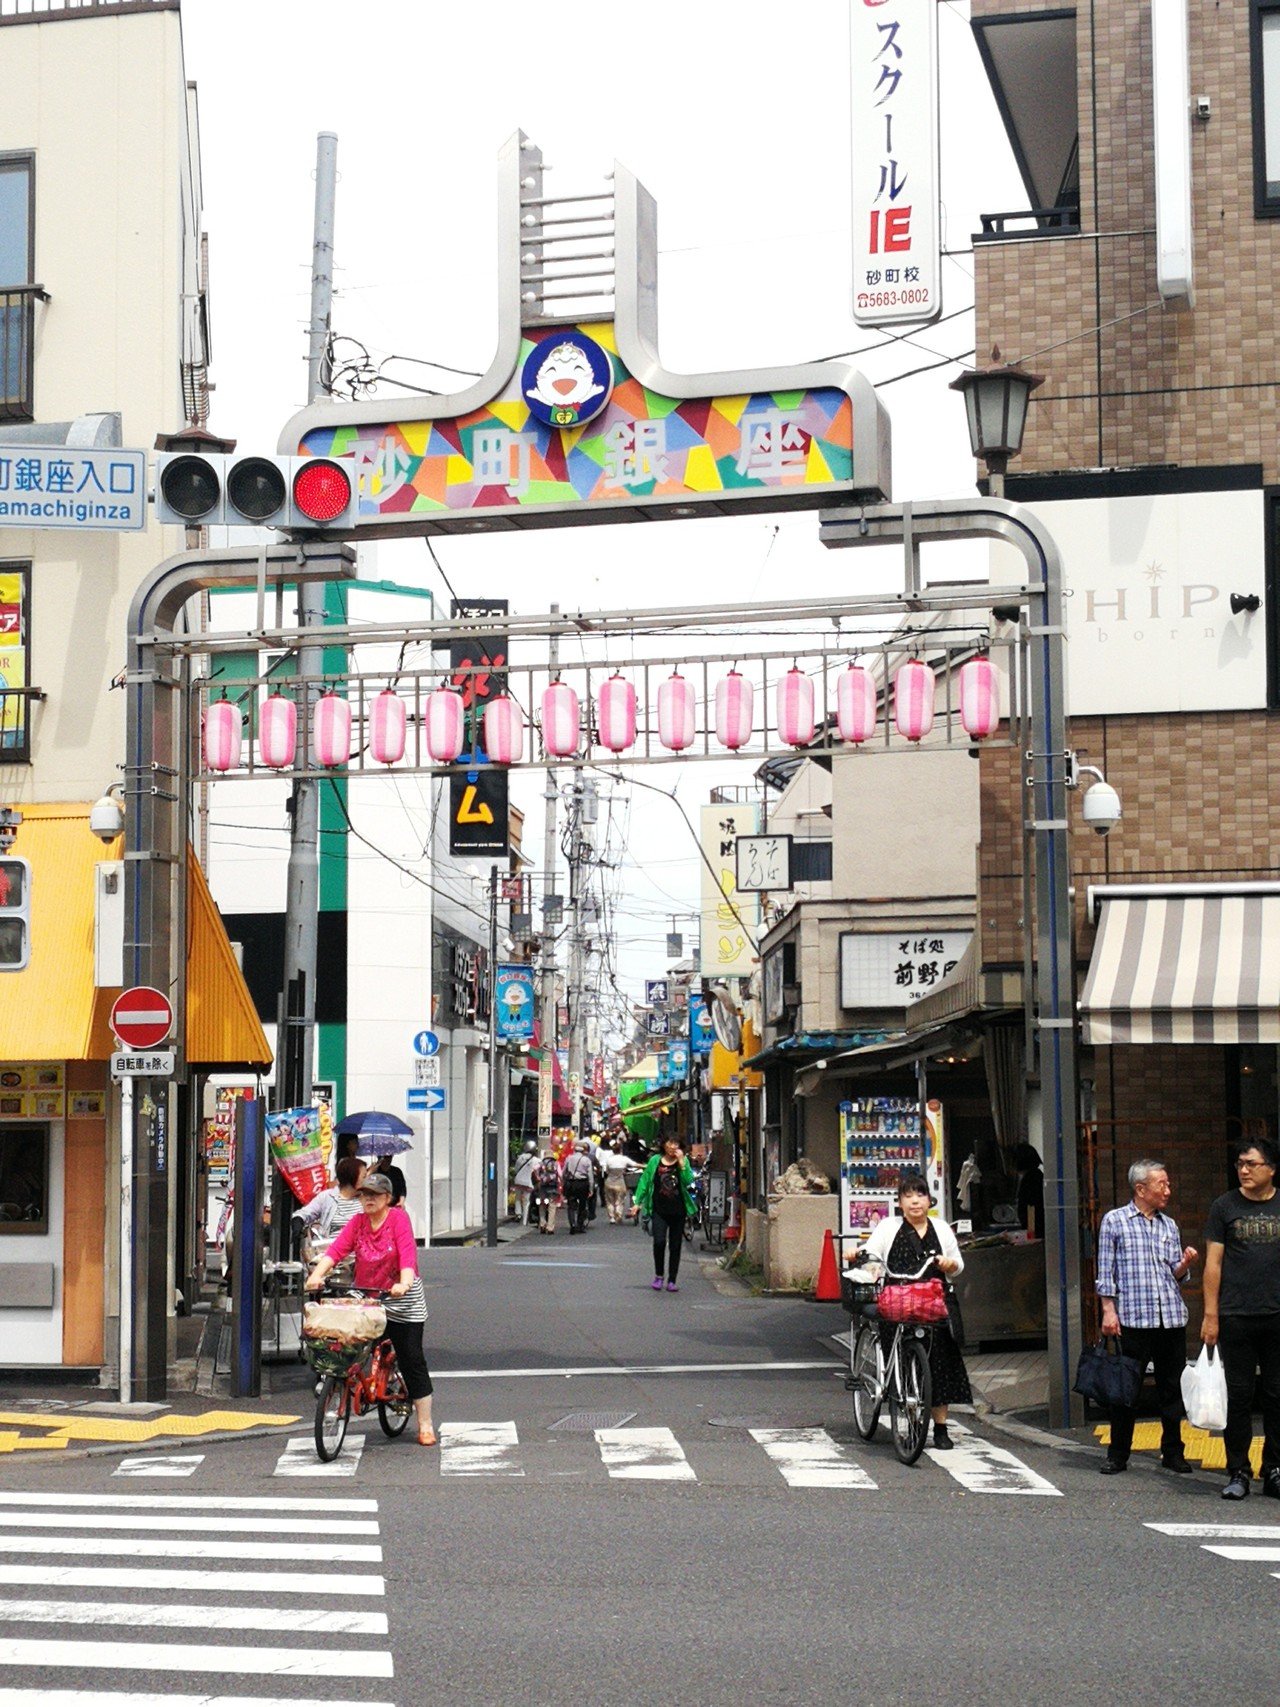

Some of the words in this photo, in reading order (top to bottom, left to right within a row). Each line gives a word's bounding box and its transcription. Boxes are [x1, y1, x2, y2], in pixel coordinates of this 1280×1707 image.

[871, 20, 908, 204] スクール
[869, 206, 912, 254] IE
[866, 266, 920, 286] 砂町校
[869, 288, 929, 308] 5683-0802
[347, 407, 806, 505] 砂町銀座
[1085, 584, 1220, 622] HIP
[1098, 627, 1215, 643] born
[899, 938, 945, 955] そば処
[116, 1057, 169, 1071] 自転車を除く
